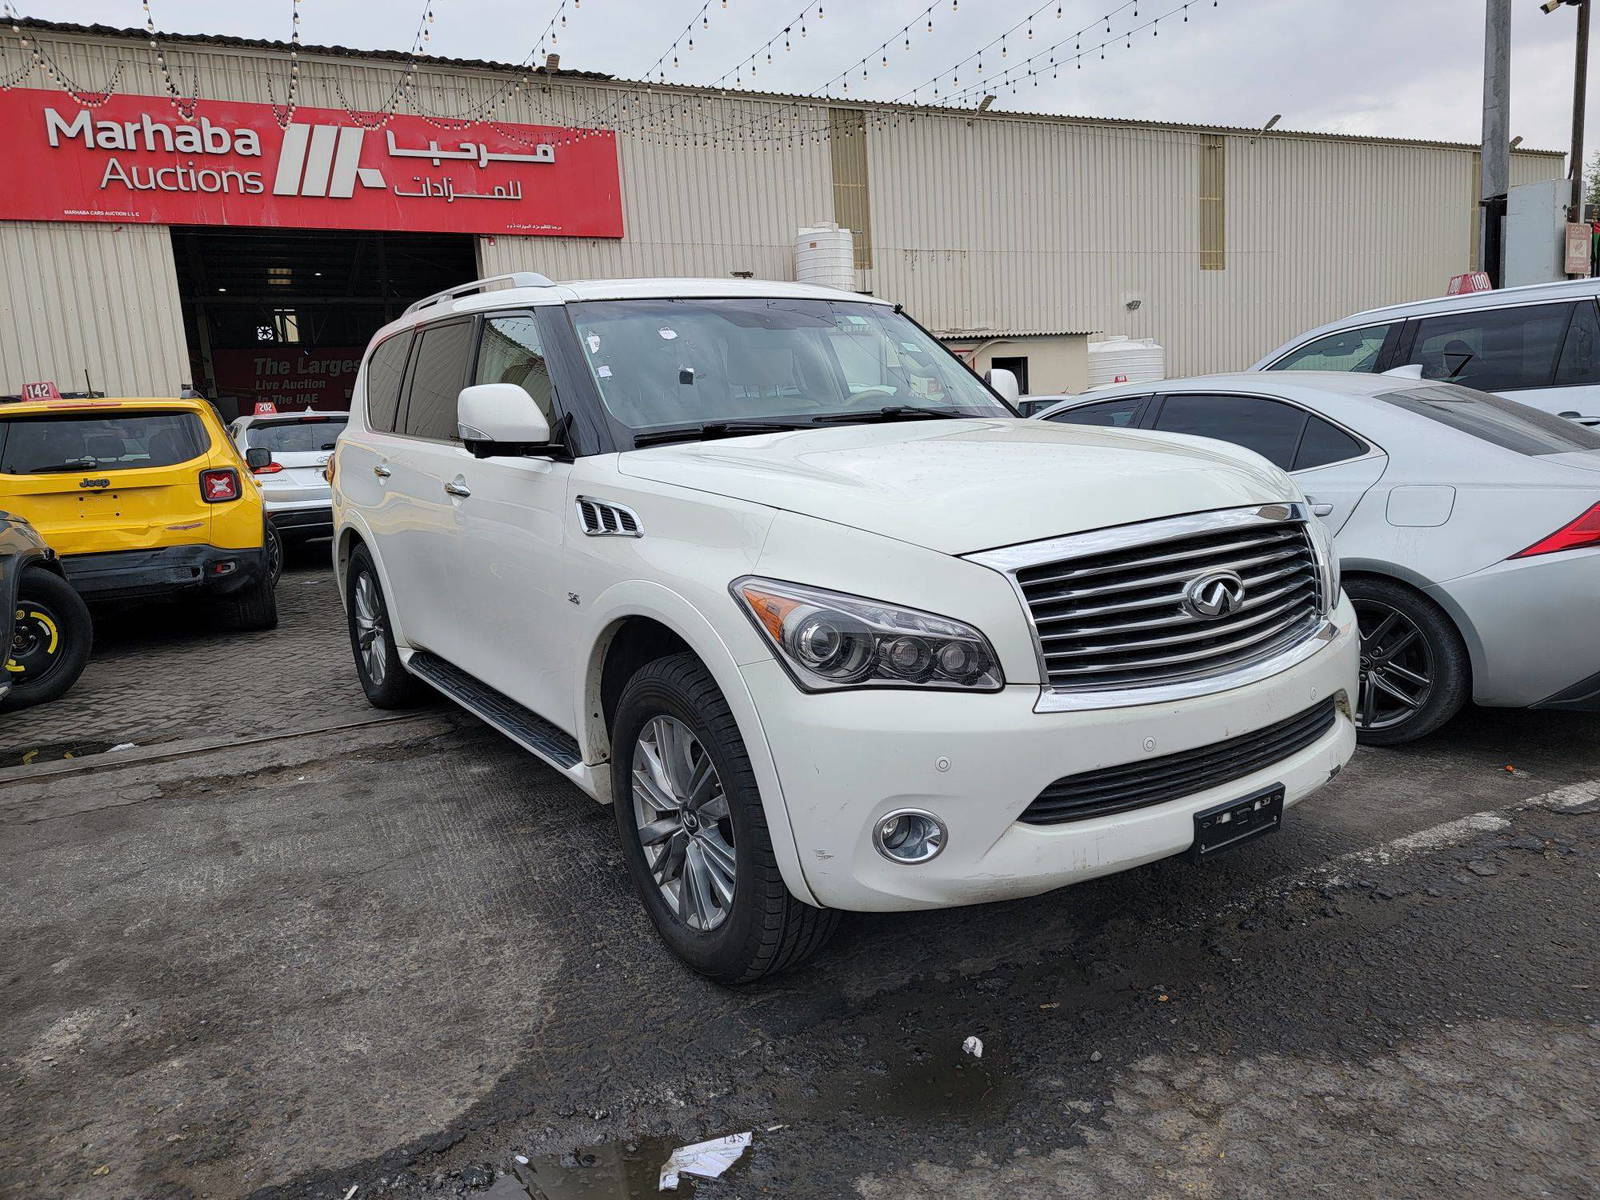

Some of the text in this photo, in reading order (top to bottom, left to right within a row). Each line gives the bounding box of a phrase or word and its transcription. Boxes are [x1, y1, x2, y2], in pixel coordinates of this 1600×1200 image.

[44, 107, 262, 157] Marhaba
[386, 129, 556, 168] مرحبا
[100, 157, 265, 195] Auctions
[394, 176, 522, 203] للمزادات
[1471, 273, 1489, 290] 100
[254, 356, 362, 377] The Larges
[28, 383, 50, 398] 142
[255, 379, 326, 390] Live Auction
[259, 402, 272, 412] 202
[272, 394, 293, 404] The
[296, 393, 319, 404] UAE
[79, 478, 110, 488] Jeep
